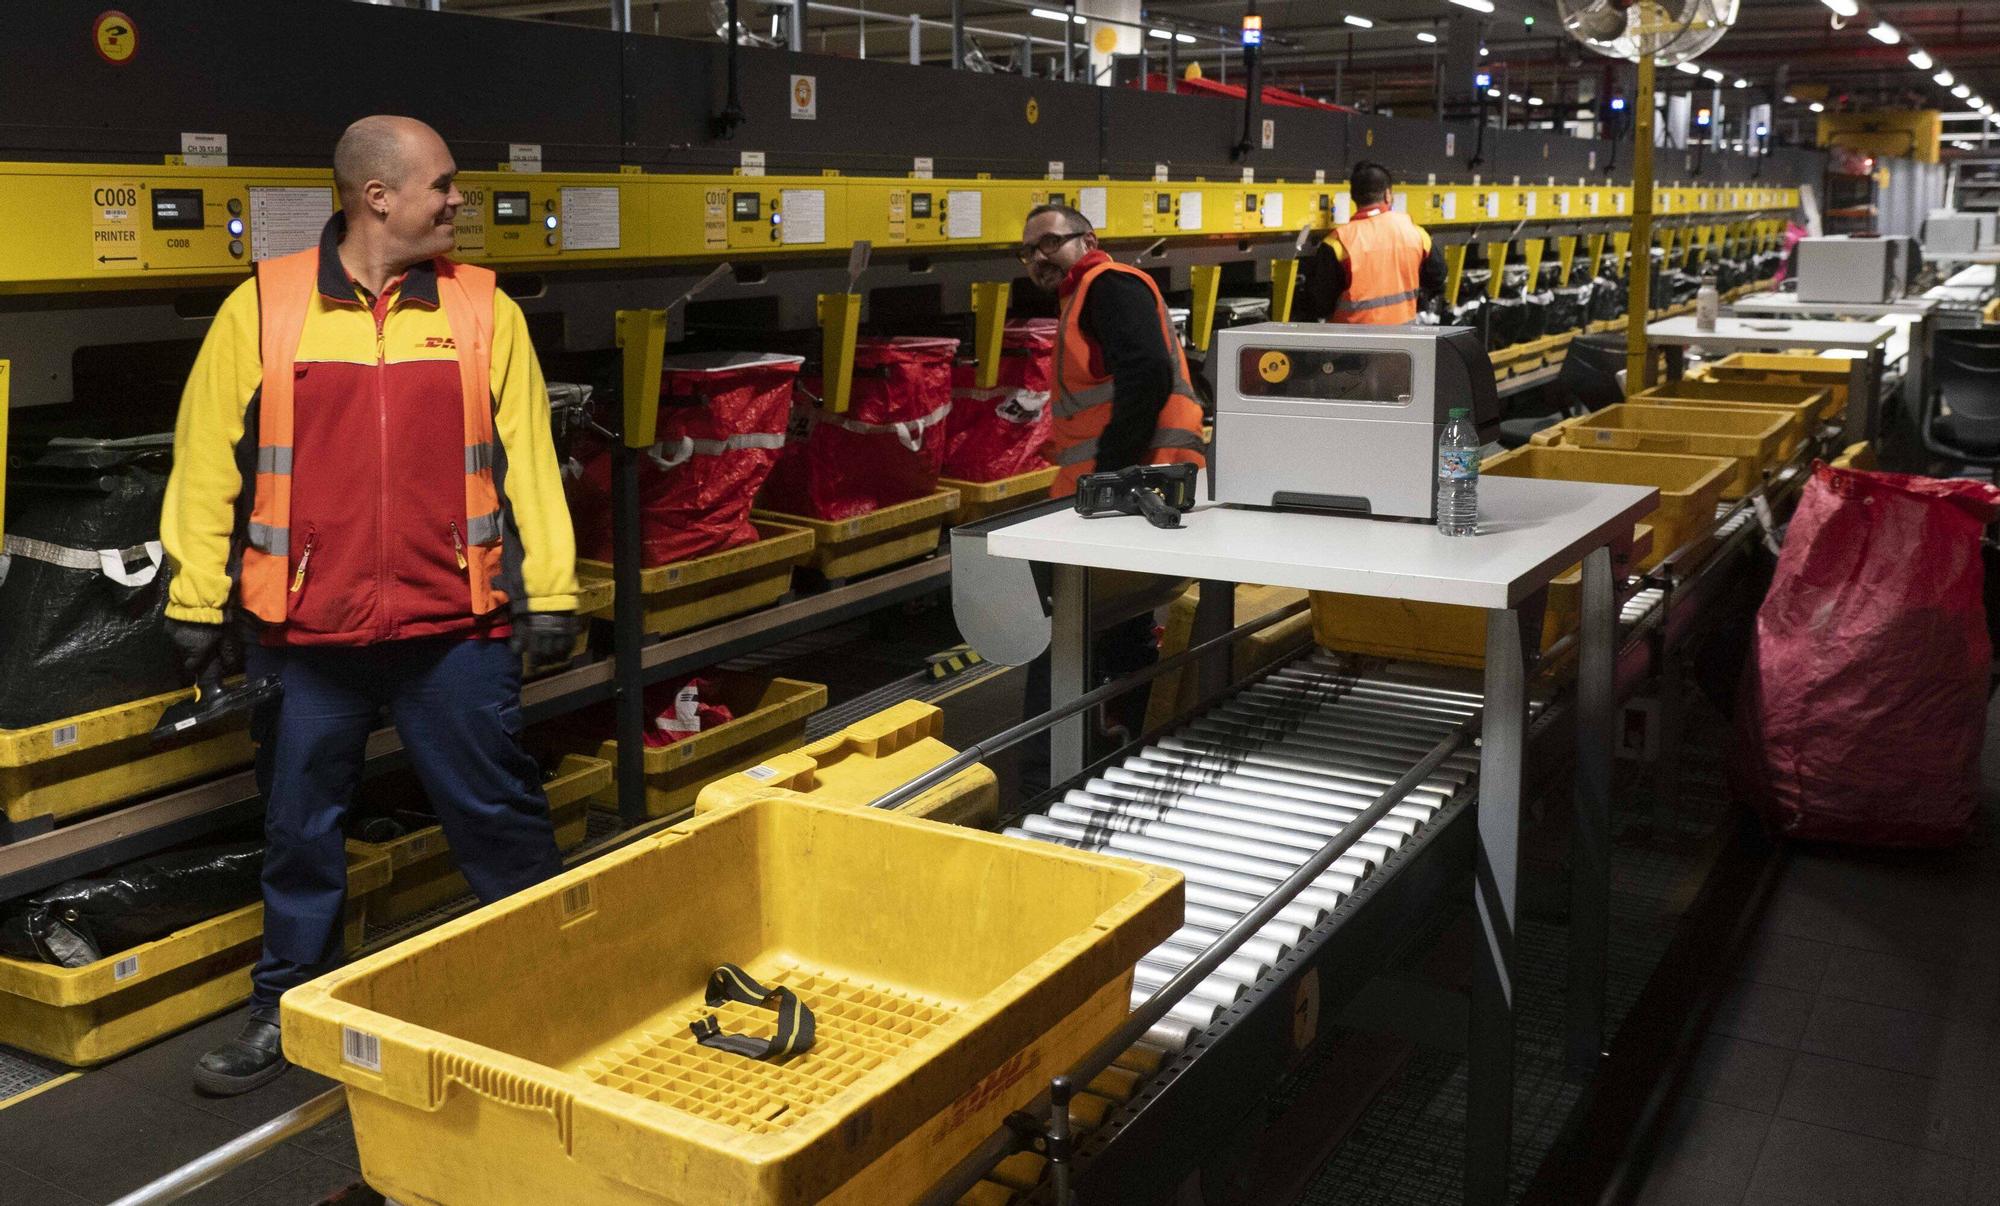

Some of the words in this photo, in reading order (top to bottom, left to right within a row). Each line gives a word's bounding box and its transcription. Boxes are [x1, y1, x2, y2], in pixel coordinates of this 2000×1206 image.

[94, 188, 137, 207] C008
[459, 190, 484, 206] 009
[705, 191, 726, 205] C010
[94, 230, 136, 242] PRINTER
[455, 225, 484, 235] PRINTER
[503, 231, 520, 241] C009
[167, 238, 190, 248] C008
[425, 337, 456, 349] DH
